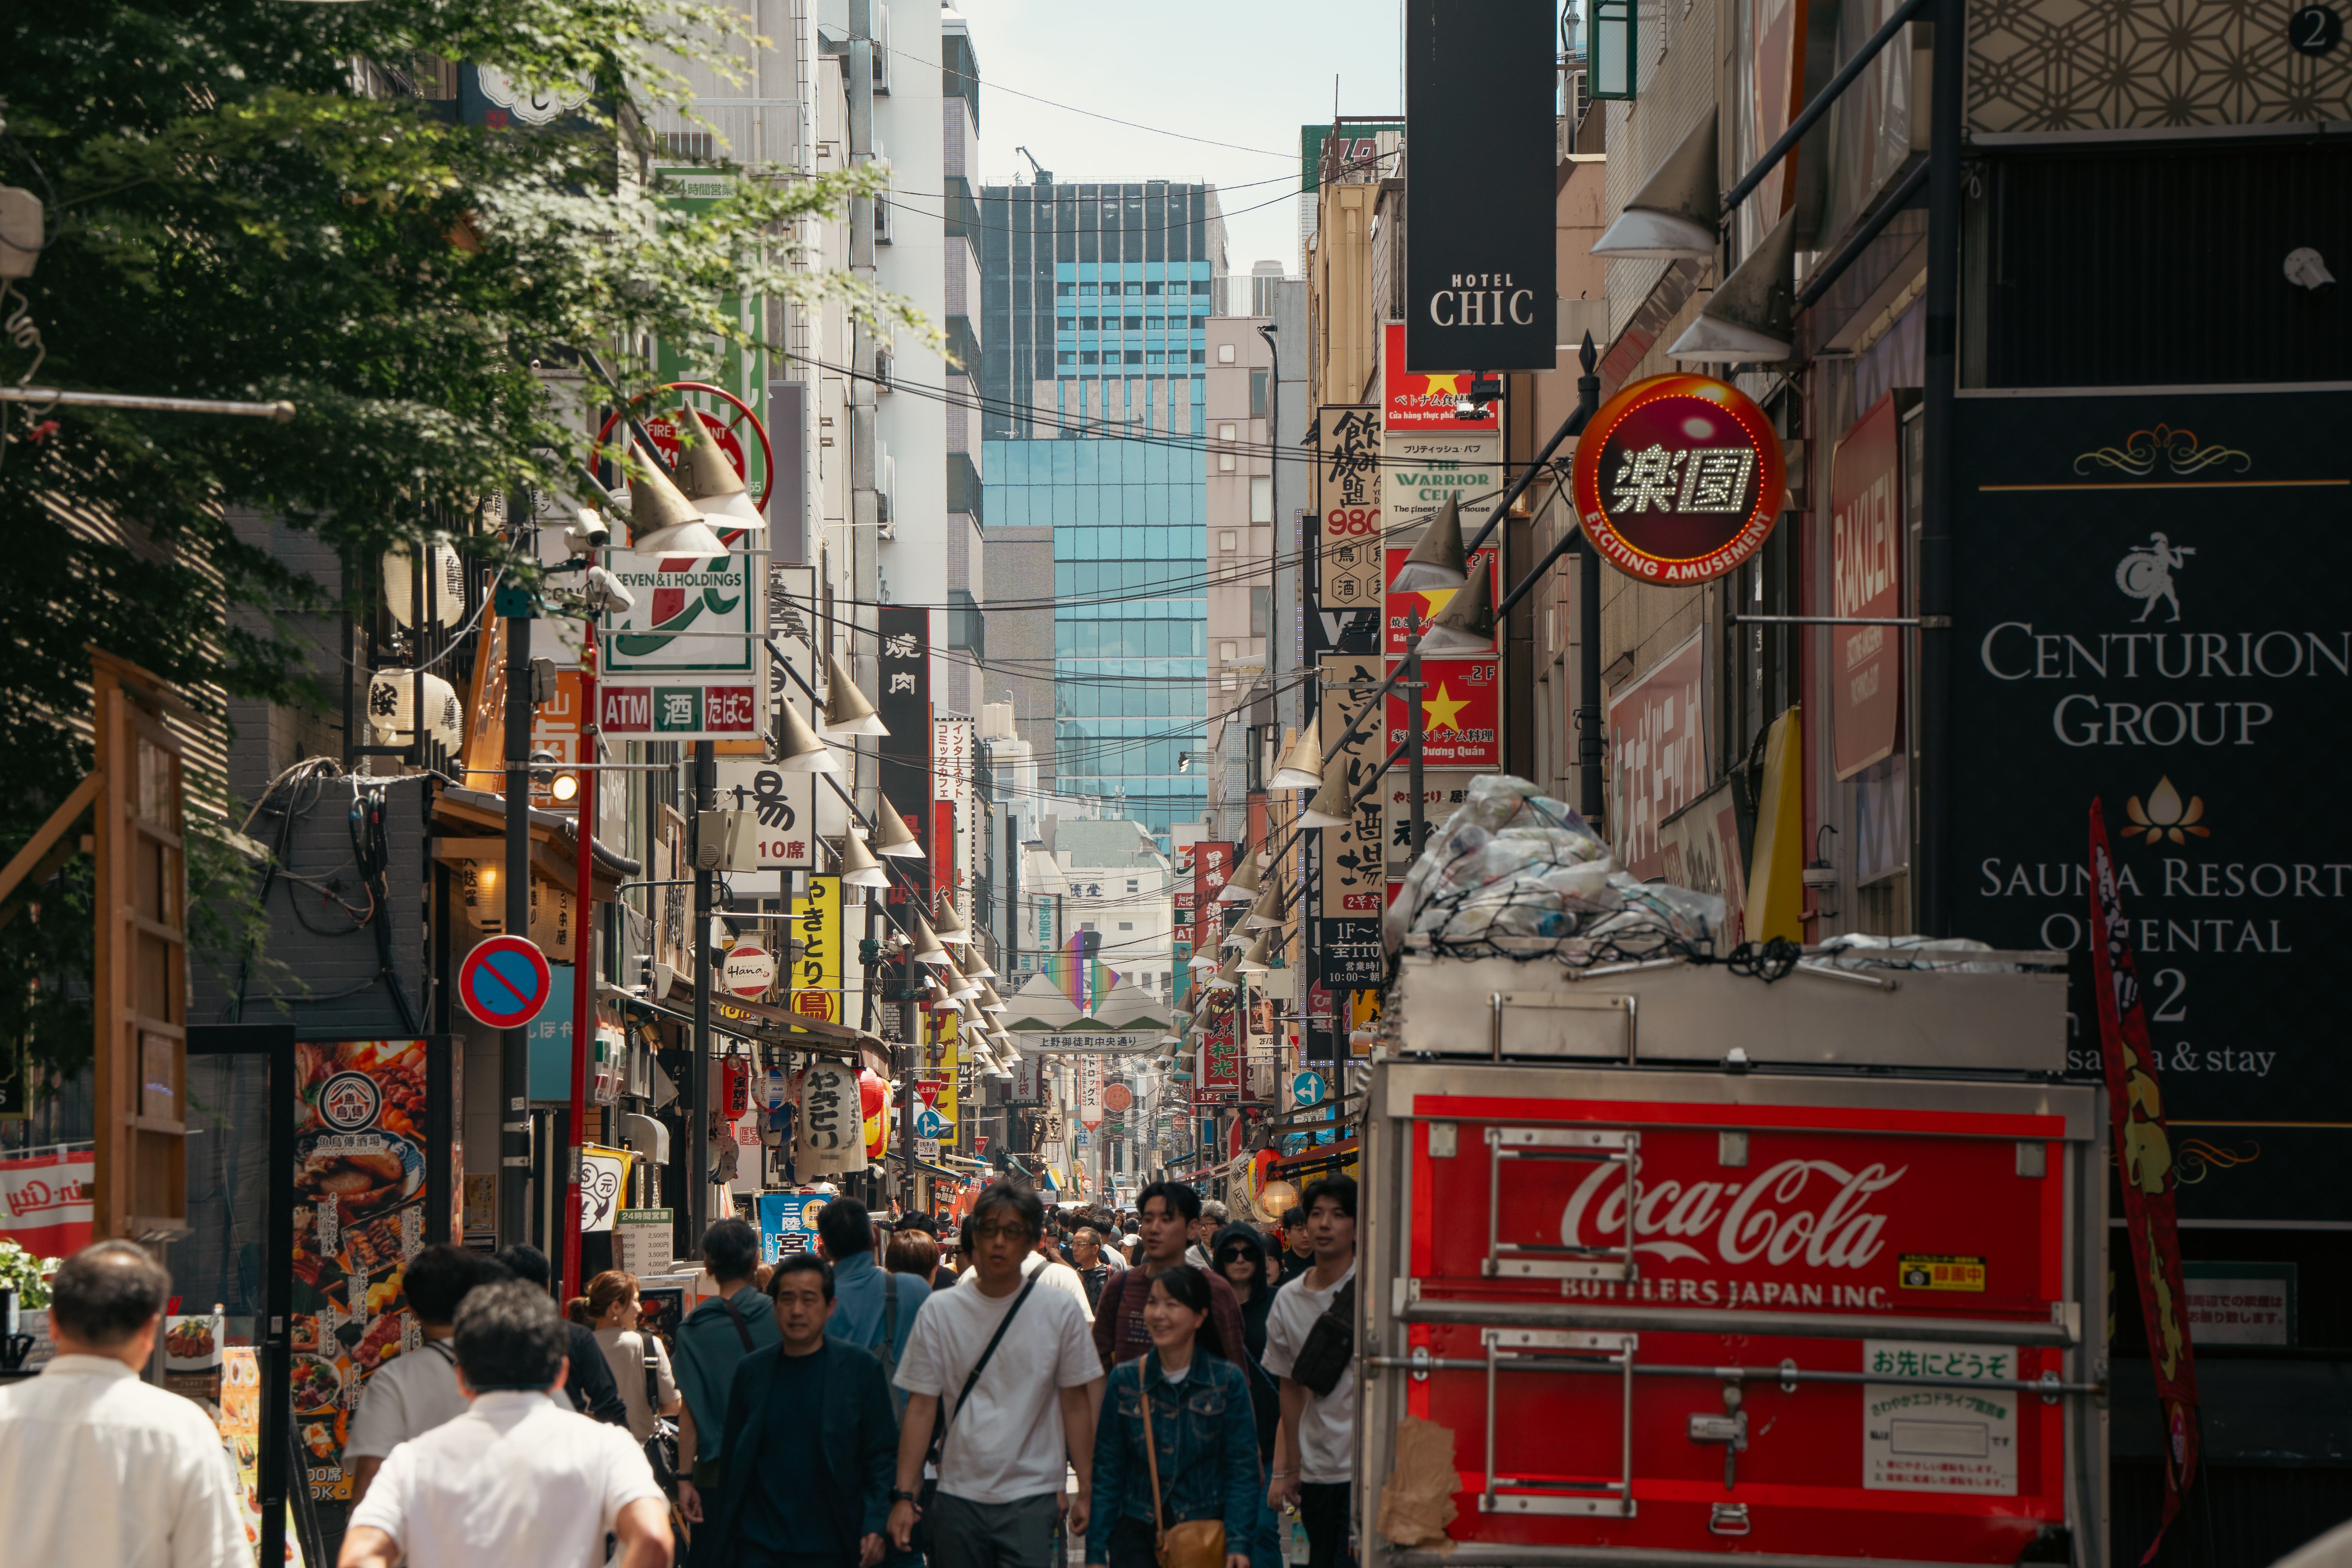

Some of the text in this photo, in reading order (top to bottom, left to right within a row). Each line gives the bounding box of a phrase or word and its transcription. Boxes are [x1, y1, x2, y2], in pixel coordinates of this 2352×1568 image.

[2303, 10, 2327, 46] 2
[1452, 274, 1513, 287] HOTEL
[1430, 290, 1533, 326] CHIC
[647, 424, 671, 437] FIRE
[1404, 412, 1421, 420] hàng
[1395, 473, 1489, 486] WARRIOR
[1609, 443, 1755, 514] 楽園
[1411, 506, 1436, 514] finest
[1338, 546, 1354, 562] 鳥
[1585, 510, 1771, 579] EXCITING AMUSEMENT
[1834, 467, 1896, 618] RAKUEN
[675, 573, 741, 587] HOLDINGS
[1338, 580, 1354, 596] 酒
[885, 633, 921, 695] 焼肉
[1980, 621, 2352, 680] CENTURION
[605, 695, 647, 724] ATM
[664, 694, 693, 726] 酒
[708, 693, 752, 724] たばこ
[2053, 694, 2273, 746] GROUP
[938, 724, 949, 798] コミックカフェ
[953, 724, 963, 799] インターネット
[1458, 746, 1485, 757] Quán
[1625, 677, 1702, 868] スギドラッグ
[759, 841, 805, 859] 10席
[2163, 858, 2352, 898] RESORT
[1039, 898, 1051, 942] PERSONAL
[1184, 911, 1195, 923] 酒
[803, 881, 826, 985] やきとり
[728, 965, 763, 978] Hana
[2152, 968, 2187, 1022] 2
[1040, 1036, 1136, 1047] 上野御徒町中央通り
[1208, 1041, 1237, 1078] 和光
[2171, 1041, 2201, 1071] &
[2207, 1045, 2276, 1077] stay
[512, 1100, 524, 1108] 25
[920, 1085, 937, 1093] 止まれ
[809, 1071, 840, 1150] やきとり
[622, 1211, 669, 1220] 24時間営業
[782, 1203, 800, 1230] 三陸
[1560, 1154, 1909, 1269] Coca-Cola
[1933, 1265, 1982, 1283] 録画中
[1728, 1280, 1827, 1308] JAPAN
[1832, 1284, 1892, 1309] INC.
[1873, 1350, 2009, 1379] お先にどうぞ
